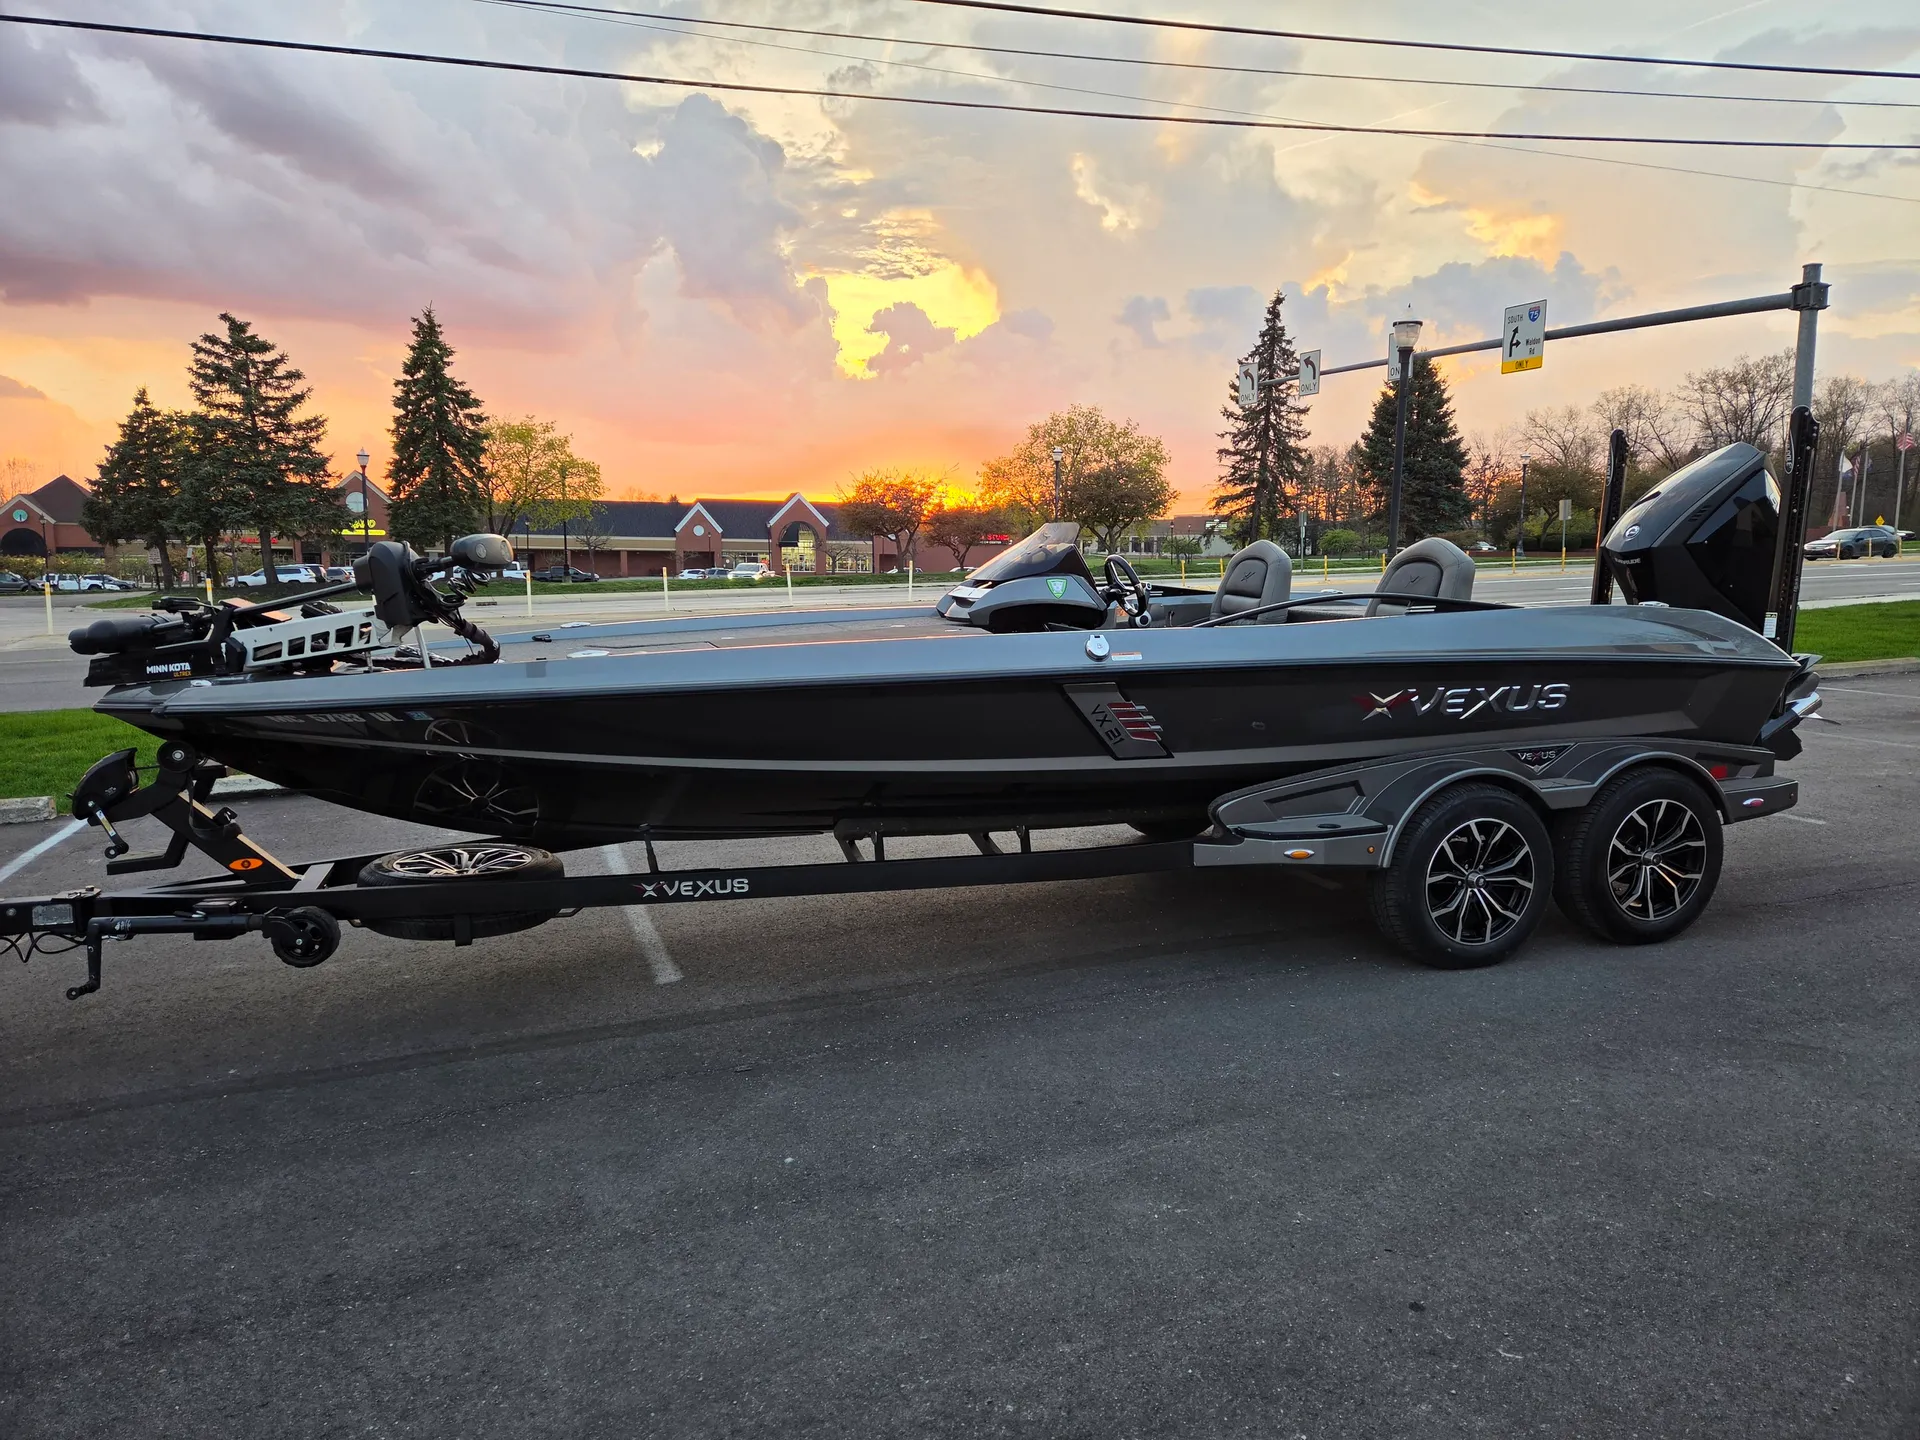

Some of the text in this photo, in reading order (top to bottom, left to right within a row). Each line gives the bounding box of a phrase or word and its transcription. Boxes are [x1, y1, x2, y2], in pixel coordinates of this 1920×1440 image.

[1507, 314, 1524, 324] SOUTH
[1529, 310, 1539, 319] 75
[1515, 360, 1529, 369] ONLY
[1300, 382, 1317, 393] ONLY
[1240, 393, 1256, 402] ONLY
[146, 662, 191, 674] MINN KOTA
[1407, 683, 1571, 720] VEXUS
[1517, 751, 1556, 762] VEXUS
[660, 878, 749, 898] VEXUS
